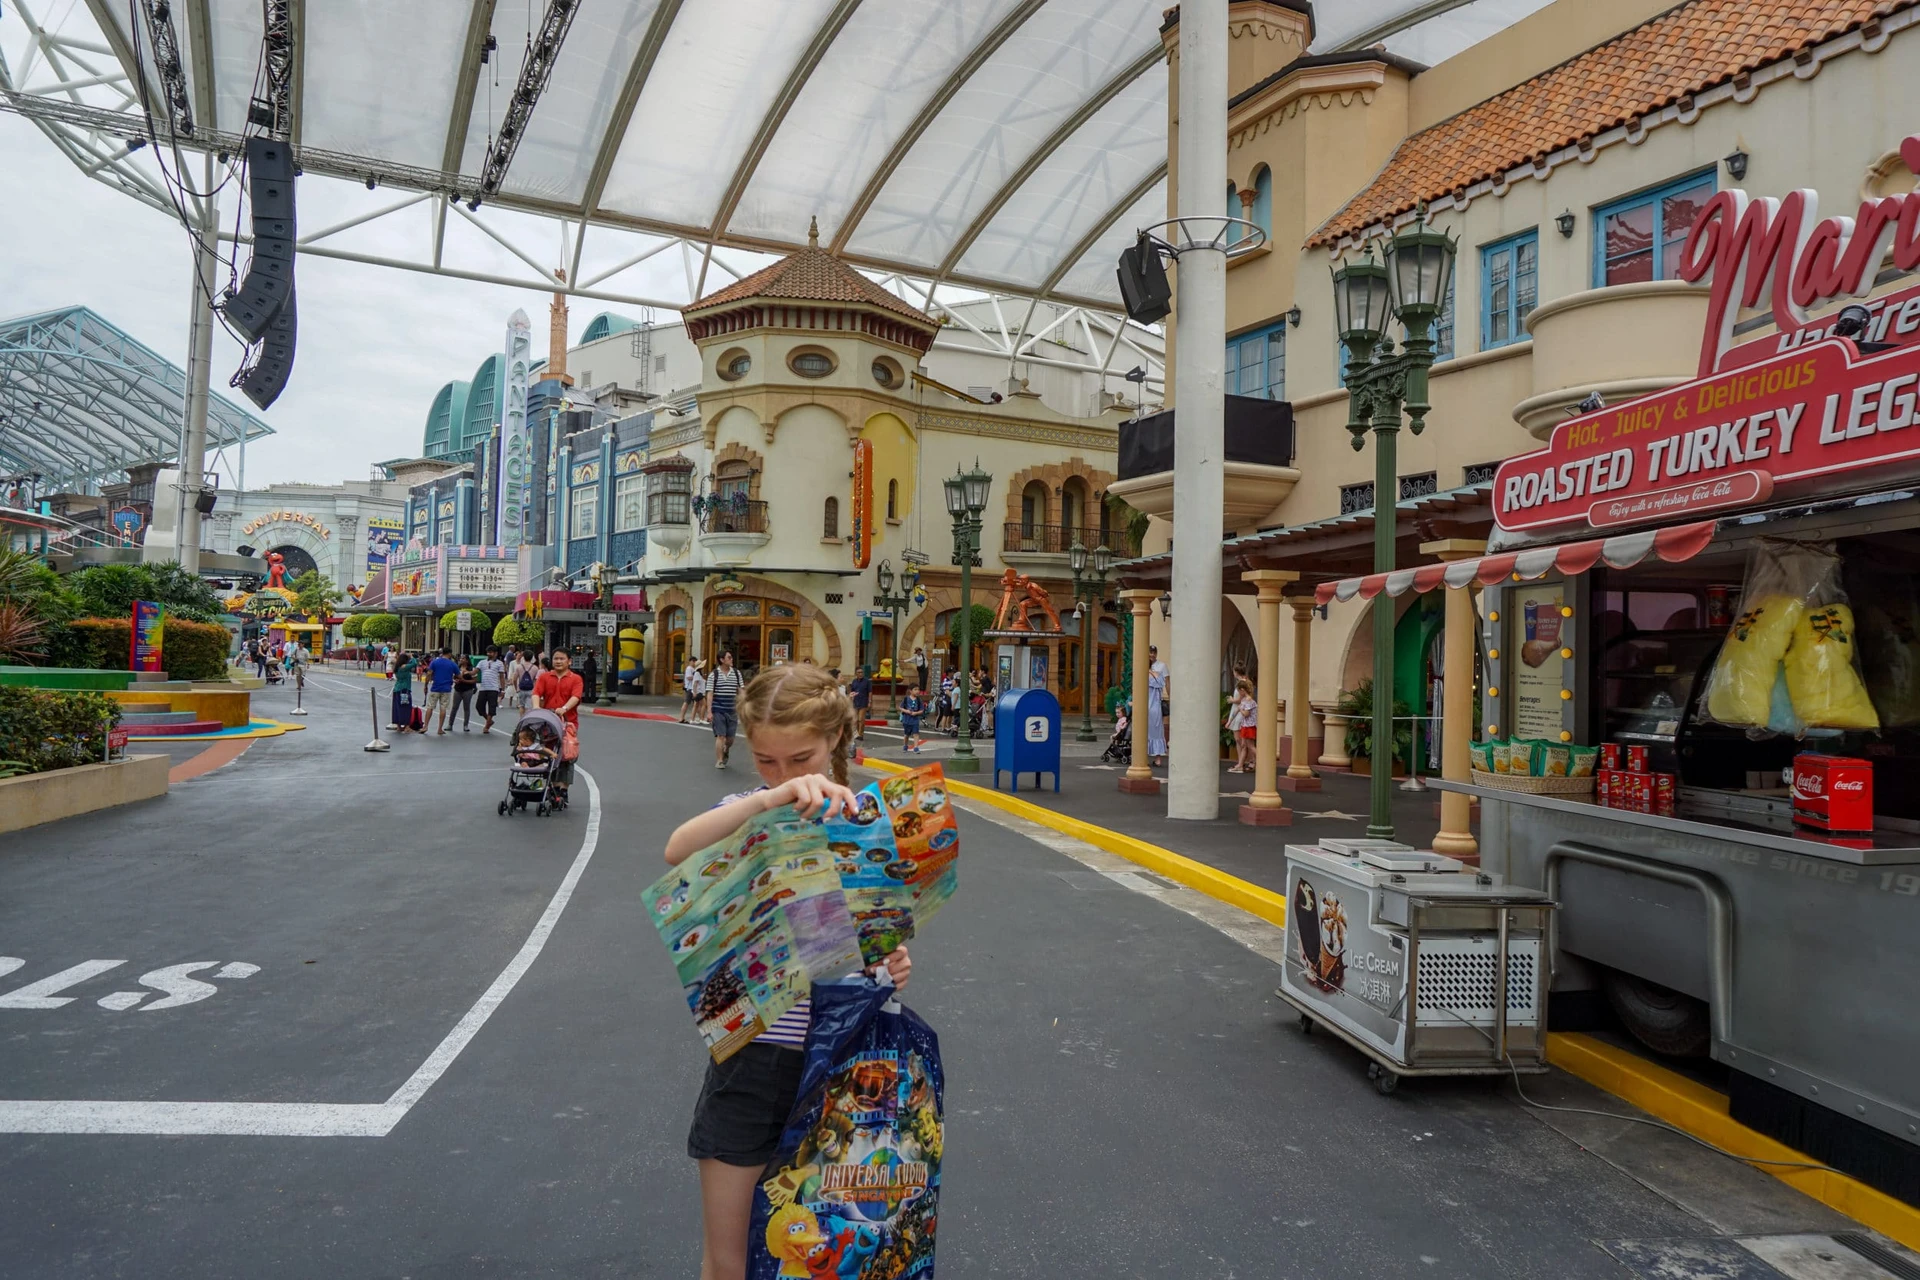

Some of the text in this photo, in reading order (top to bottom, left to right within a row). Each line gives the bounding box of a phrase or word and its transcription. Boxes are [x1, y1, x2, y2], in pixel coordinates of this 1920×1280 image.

[1567, 358, 1817, 451] Hot, Juicy & Delicious
[505, 336, 529, 528] PANTAGES
[1502, 446, 1635, 513] ROASTED
[1646, 401, 1806, 484] TURKEY
[1692, 480, 1732, 501] Coca-Cola
[115, 512, 139, 525] HOTEL
[242, 511, 330, 541] UNIVERSAL
[459, 566, 505, 574] SHOWTIMES
[600, 625, 615, 634] 30
[1797, 772, 1823, 794] Coca-Cola
[1834, 780, 1864, 791] Coca-Cola
[1769, 854, 1859, 884] since
[1360, 976, 1391, 1004] 冰淇淋
[822, 1163, 890, 1189] UNIVERSAL
